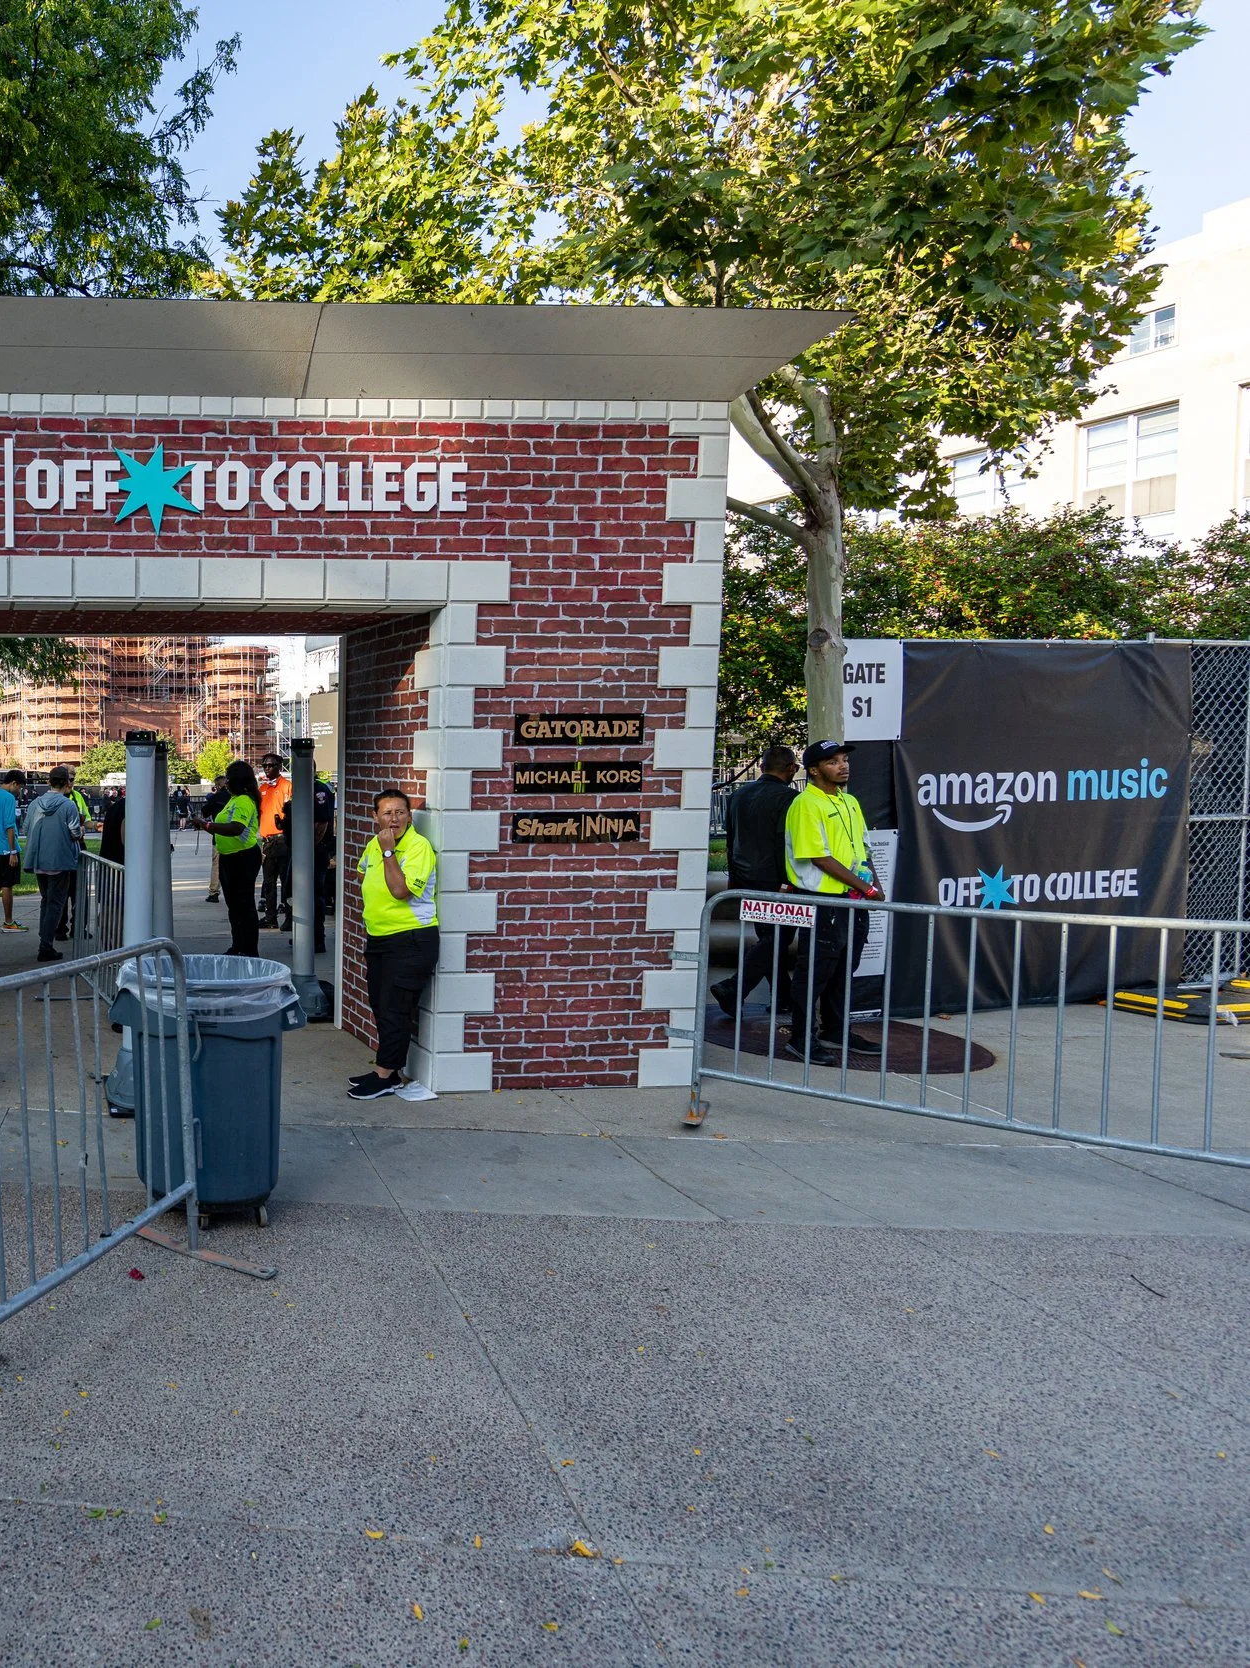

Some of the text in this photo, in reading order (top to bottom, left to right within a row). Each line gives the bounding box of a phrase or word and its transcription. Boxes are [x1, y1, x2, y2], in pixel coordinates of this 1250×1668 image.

[25, 458, 469, 513] OFF TO COLLEGE
[842, 662, 886, 685] GATE
[851, 696, 872, 718] S1
[520, 720, 640, 739] GATORADE
[515, 769, 642, 785] MICHAEL KORS
[917, 757, 1169, 807] amazon music
[515, 818, 581, 836] Shark
[938, 868, 1139, 908] OFF TO COLLEGE
[742, 900, 813, 918] NATIONAL
